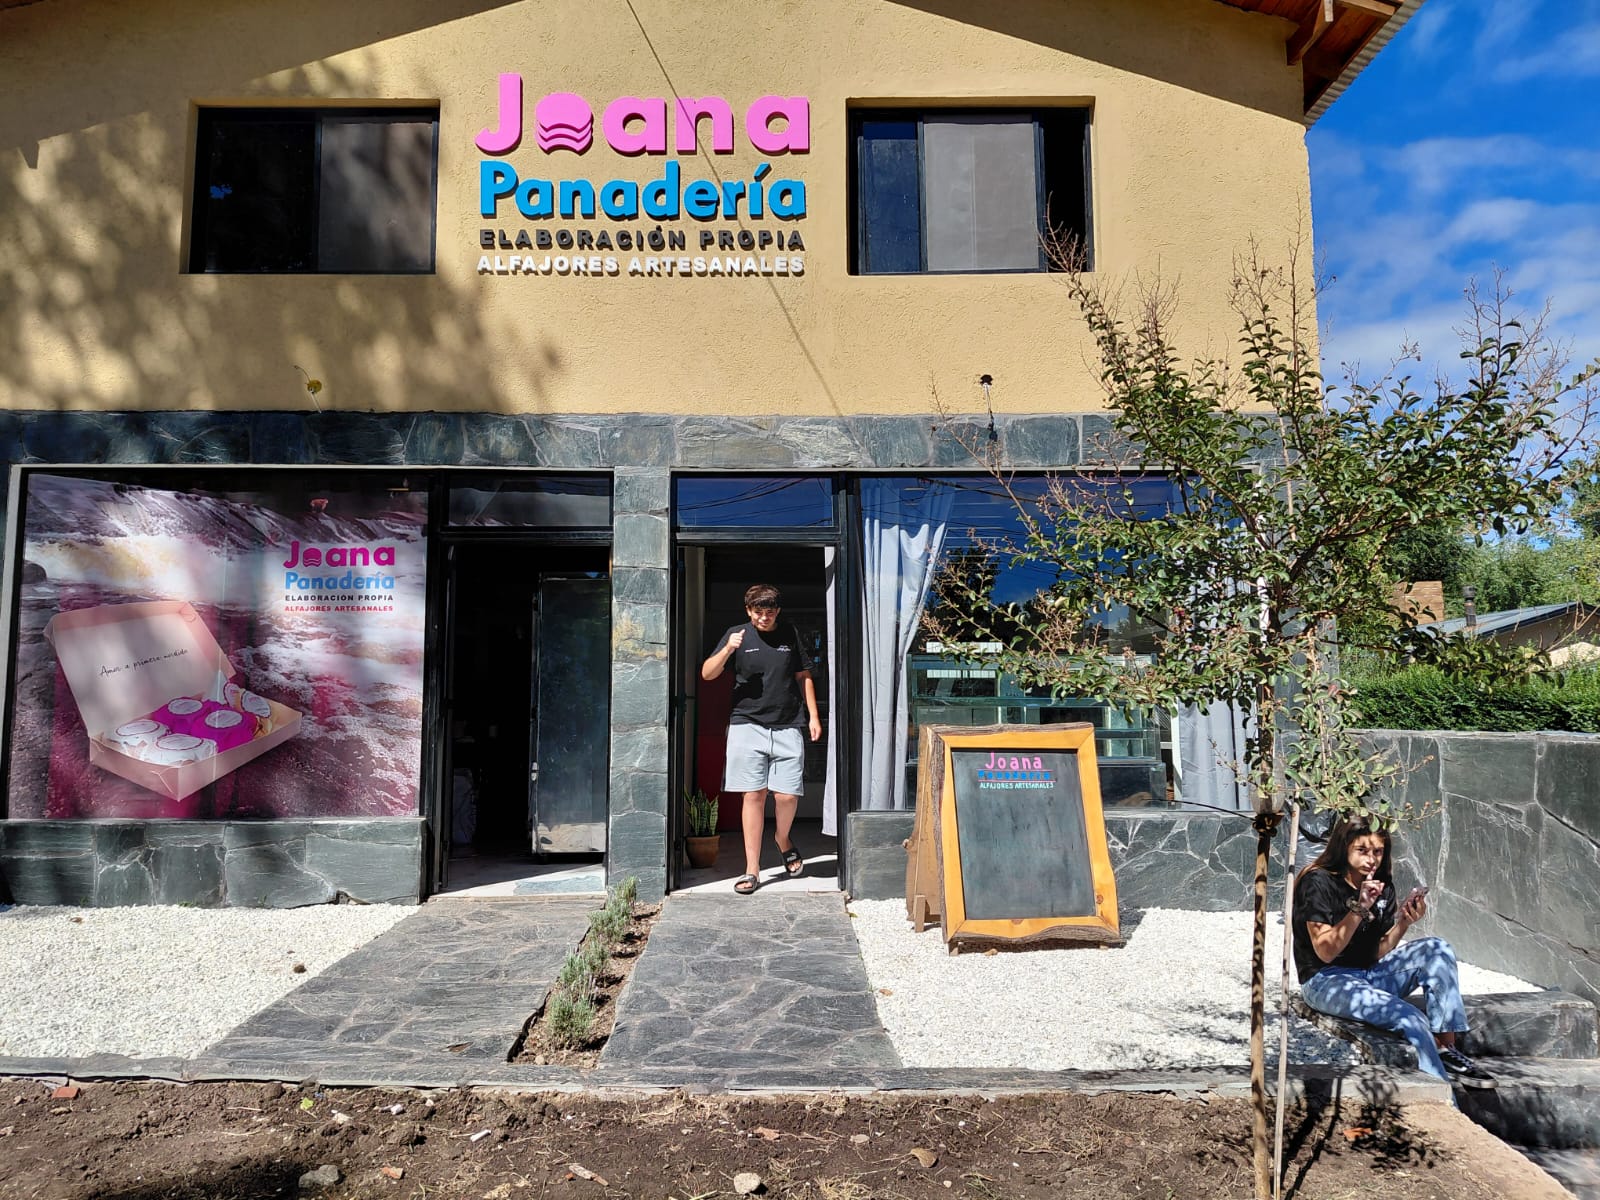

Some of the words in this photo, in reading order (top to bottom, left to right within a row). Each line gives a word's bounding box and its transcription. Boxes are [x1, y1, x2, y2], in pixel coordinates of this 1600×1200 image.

[475, 72, 810, 155] Joana
[480, 160, 807, 221] Panadería
[479, 225, 685, 250] ELABORACIÓN
[699, 229, 805, 251] PROPIA
[477, 255, 619, 275] ALFAJORES
[628, 256, 805, 277] ARTESANALES
[283, 540, 395, 569] Joana
[285, 571, 394, 590] Panadería
[358, 594, 394, 602] PROPIA
[985, 752, 1042, 770] Joana
[980, 782, 1013, 790] ALFAJORES
